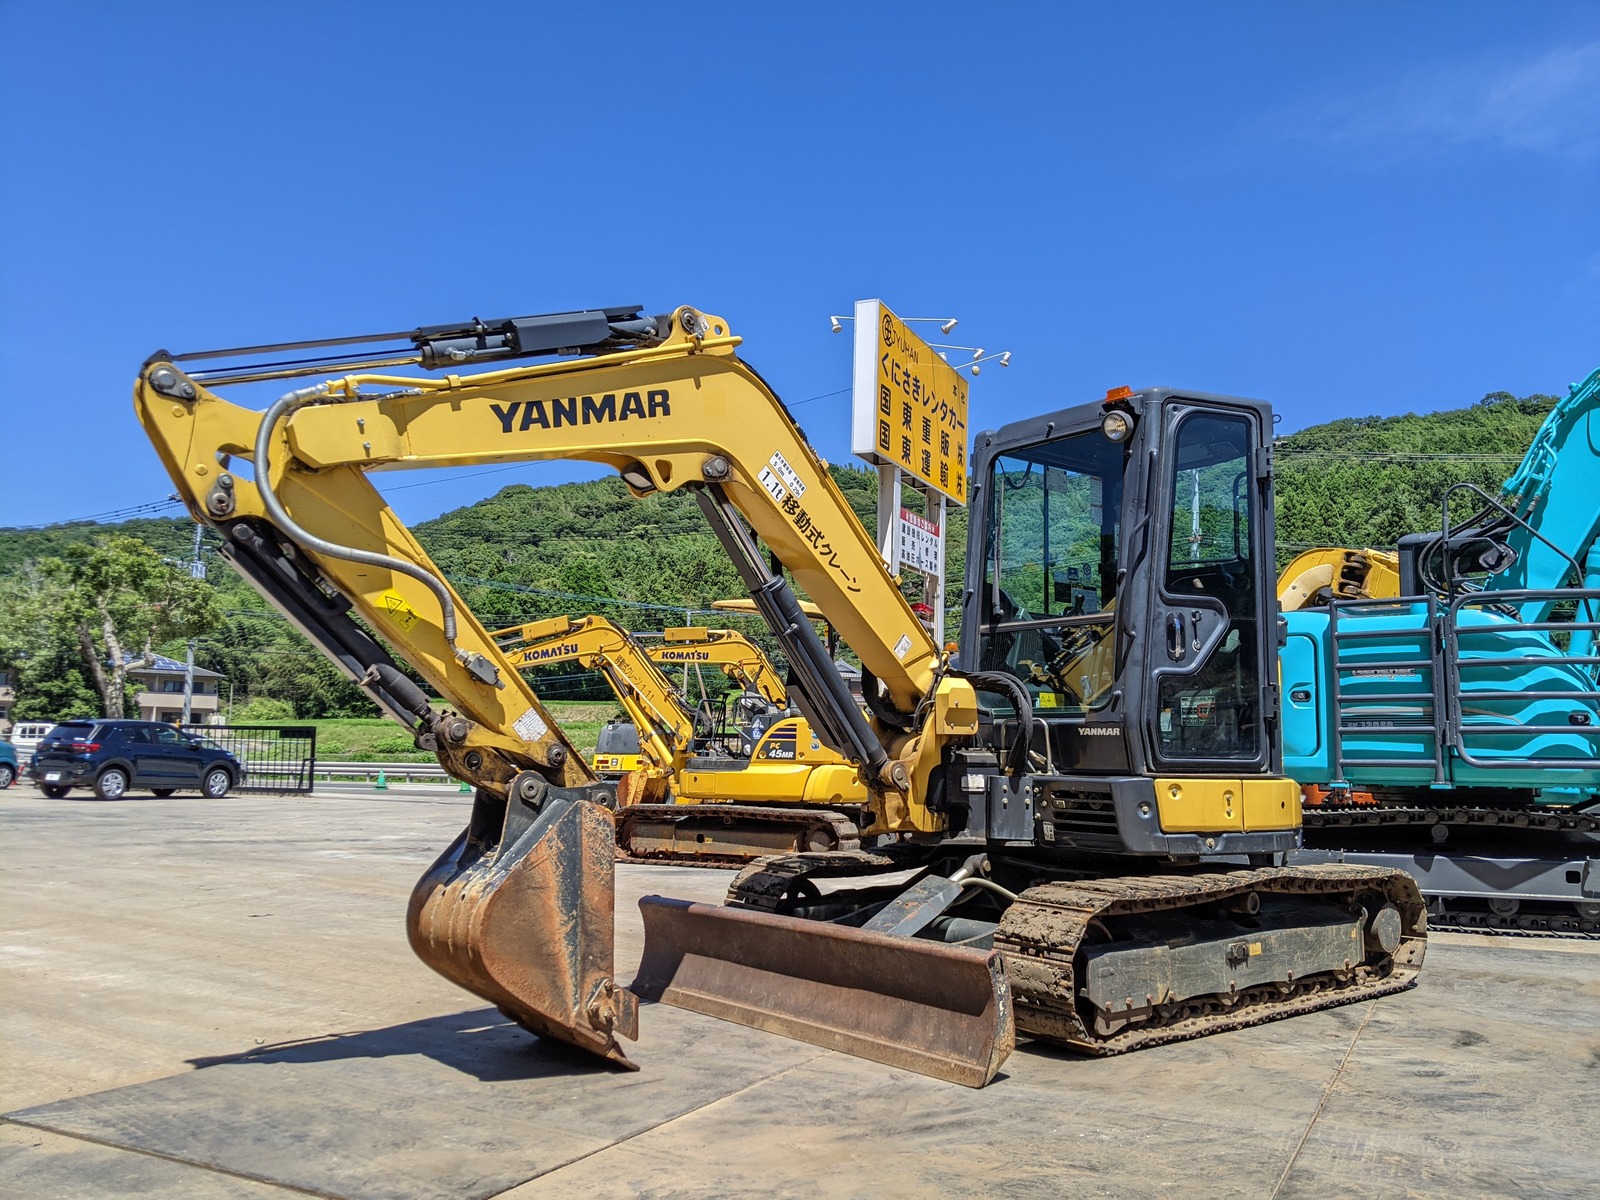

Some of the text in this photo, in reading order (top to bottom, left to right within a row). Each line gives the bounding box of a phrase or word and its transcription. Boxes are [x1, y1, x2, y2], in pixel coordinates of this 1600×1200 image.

[892, 329, 919, 365] JYUHAN
[881, 352, 965, 431] くにさきレンタカー
[489, 389, 671, 433] YANMAR
[762, 470, 783, 500] 1.1t
[781, 492, 861, 592] 移動式クレーン
[524, 643, 579, 661] KOMATSU
[661, 650, 709, 660] KOMATSU
[1078, 727, 1120, 736] YANMAR
[768, 750, 794, 759] 45MR
[769, 742, 781, 750] PC
